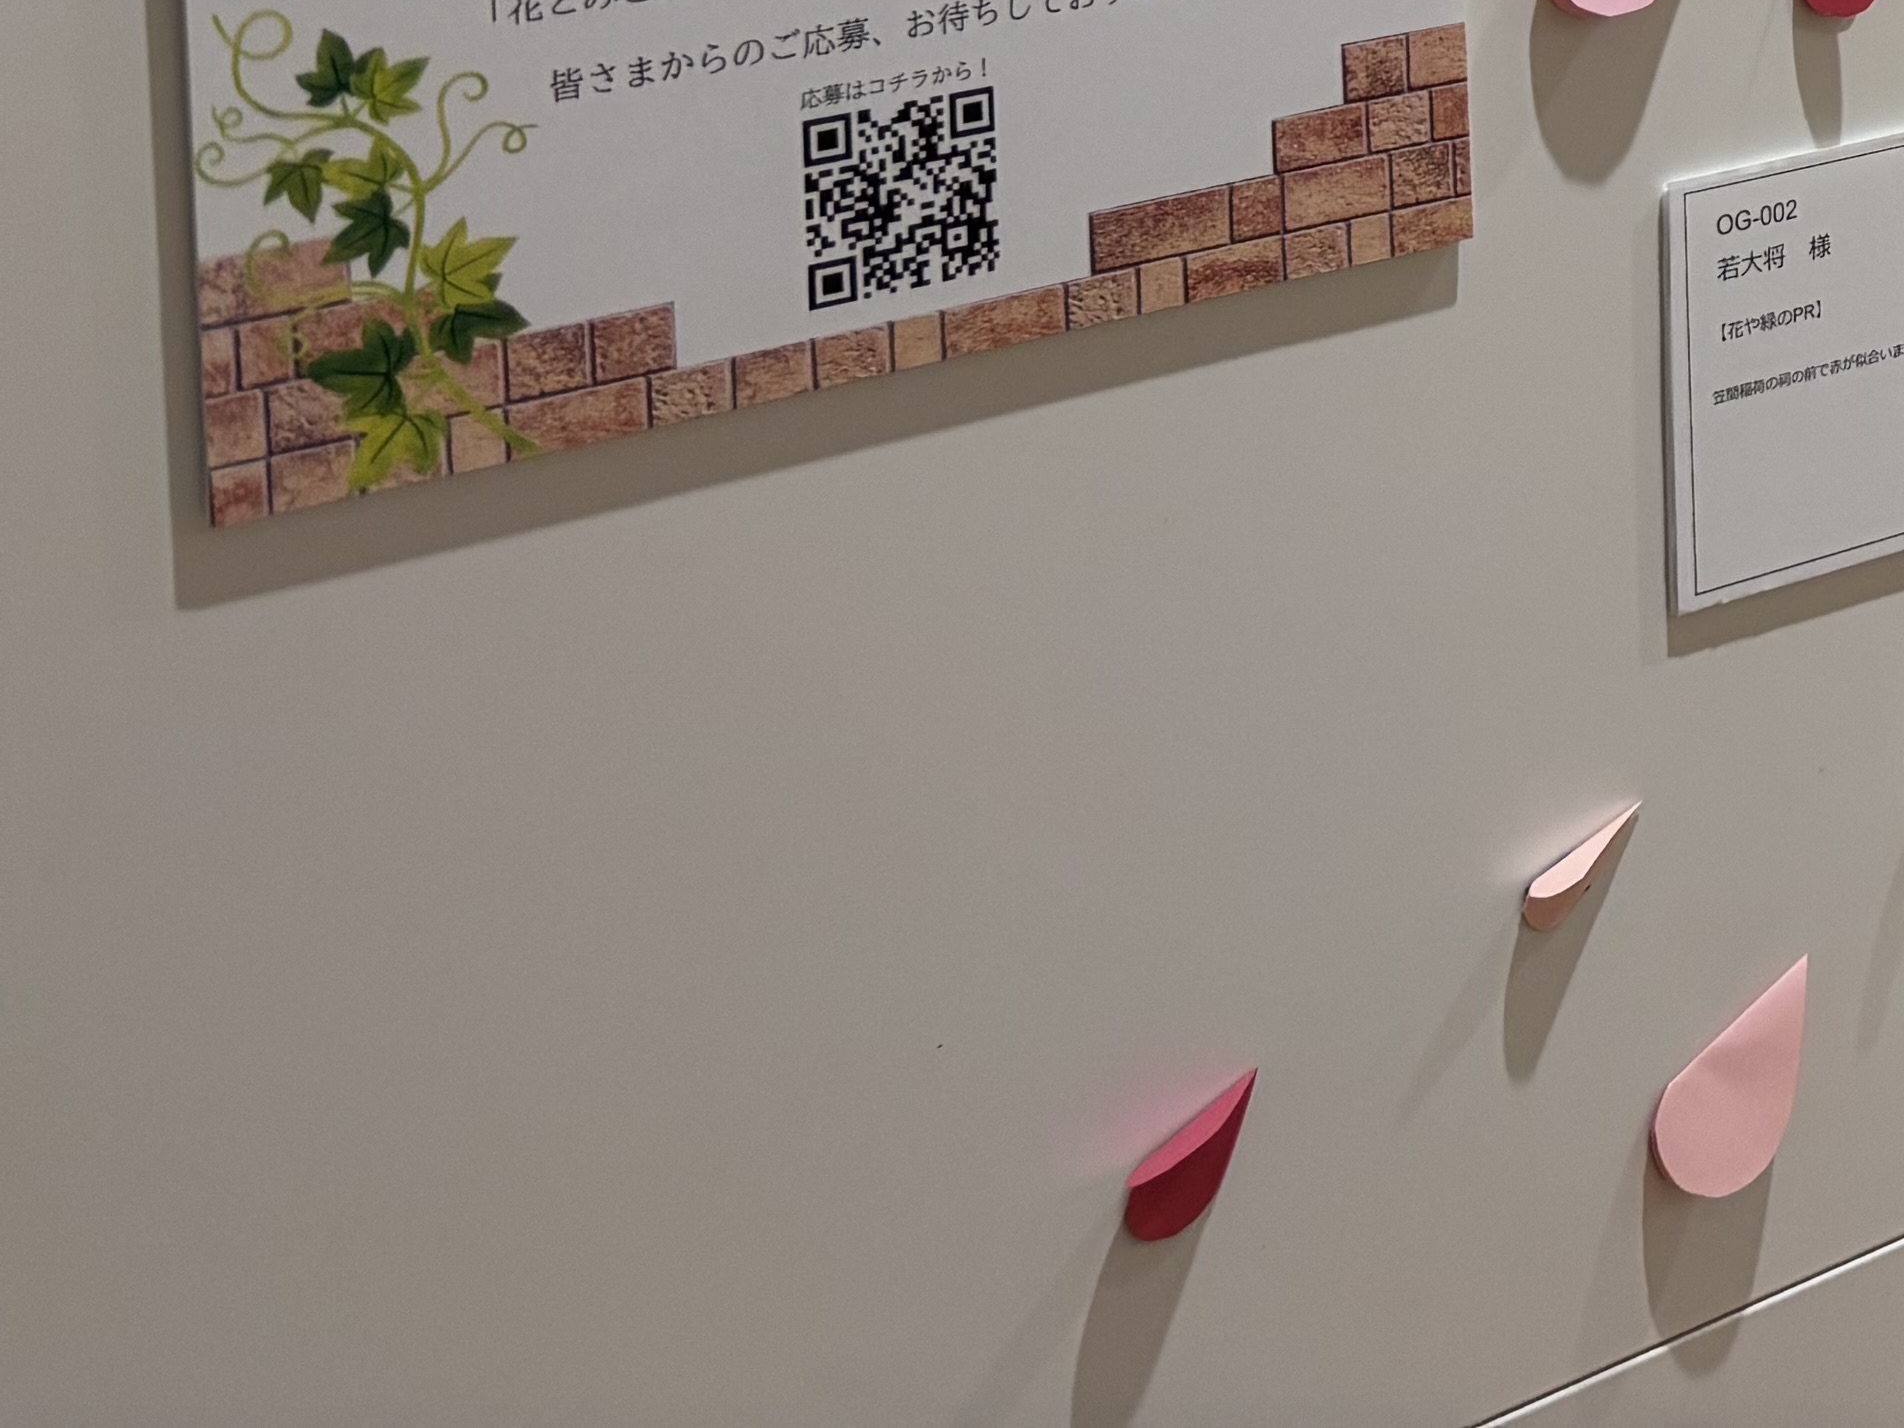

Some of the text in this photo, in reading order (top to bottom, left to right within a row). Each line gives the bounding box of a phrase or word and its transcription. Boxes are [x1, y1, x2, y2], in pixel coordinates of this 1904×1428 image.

[1715, 198, 1799, 236] OG-002
[1716, 232, 1832, 282] 若大将 様
[1720, 299, 1823, 343] 【花や緑のPR】
